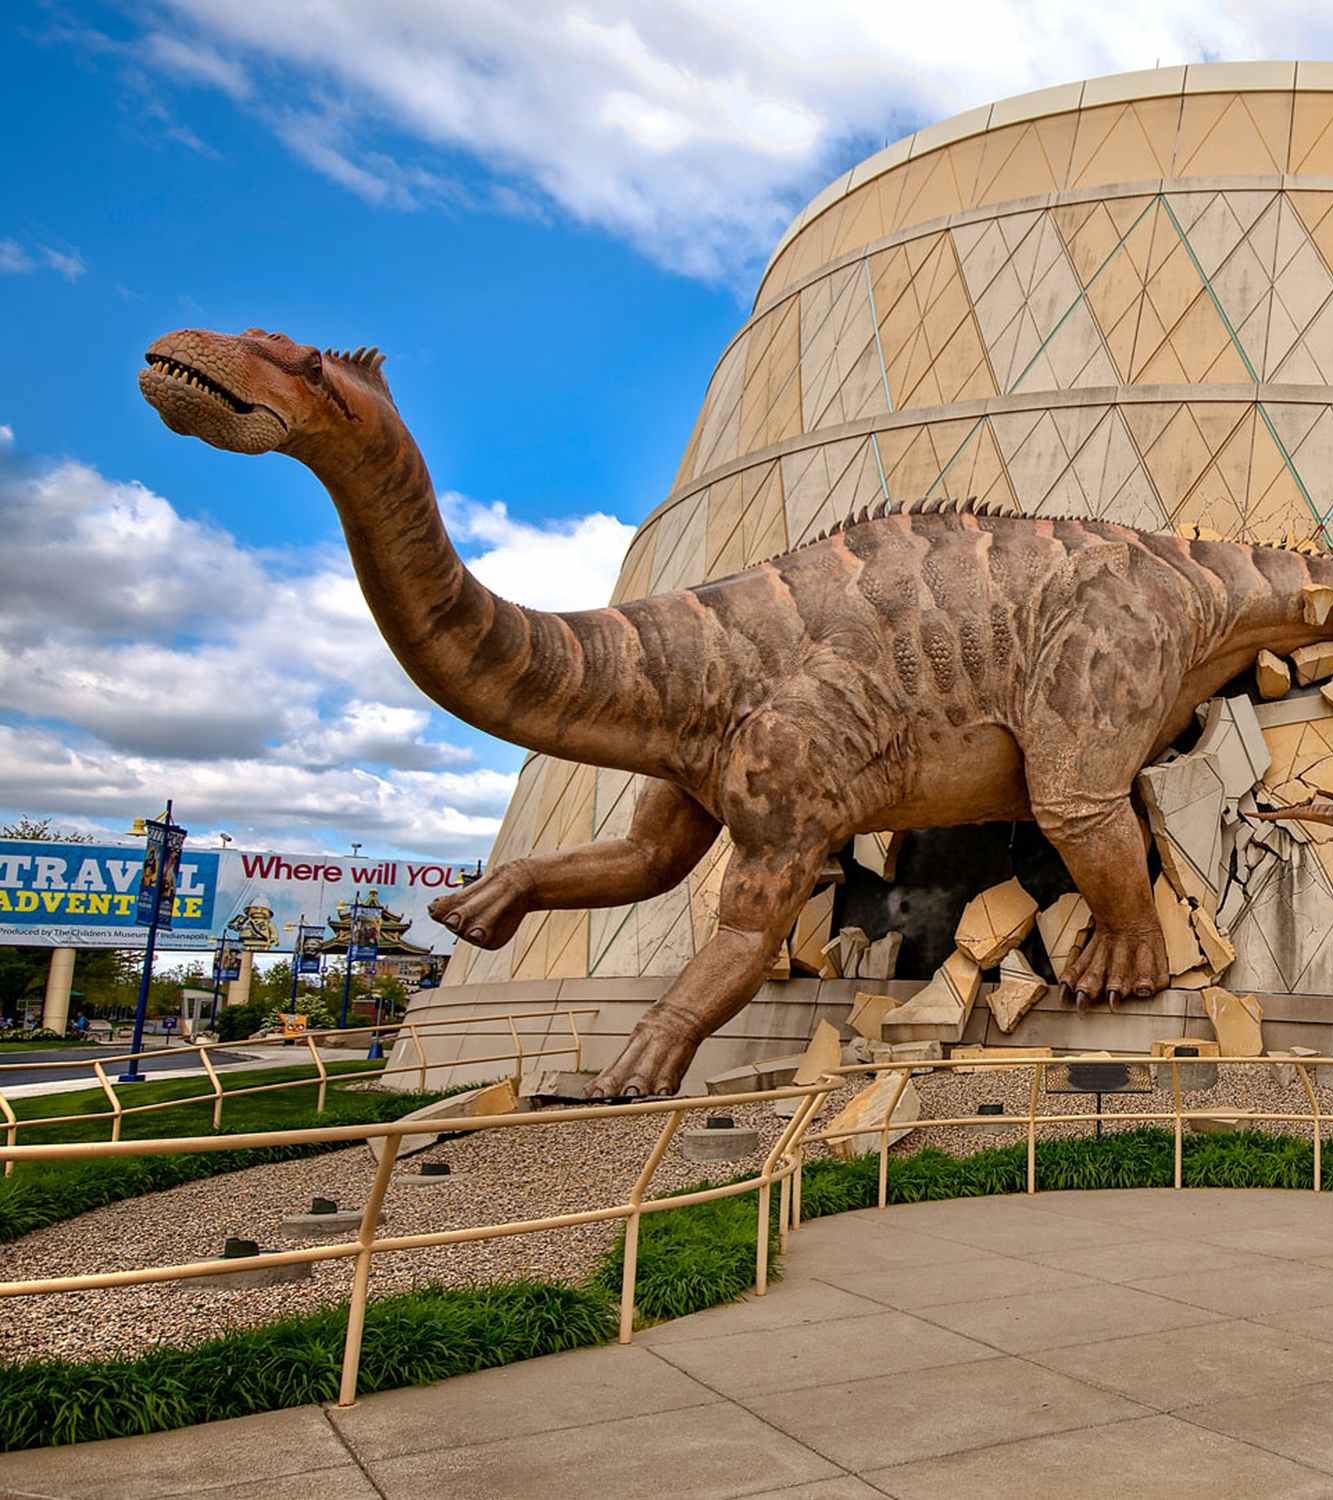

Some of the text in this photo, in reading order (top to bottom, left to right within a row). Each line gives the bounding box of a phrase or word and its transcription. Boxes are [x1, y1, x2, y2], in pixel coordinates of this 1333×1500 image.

[0, 855, 205, 896] TRAVL
[241, 855, 465, 889] Where will YOU
[0, 890, 204, 918] ADVENTRE
[0, 927, 40, 936] Produced
[41, 928, 52, 938] by
[54, 929, 69, 937] The
[71, 929, 112, 938] Children's
[114, 929, 147, 939] Museum
